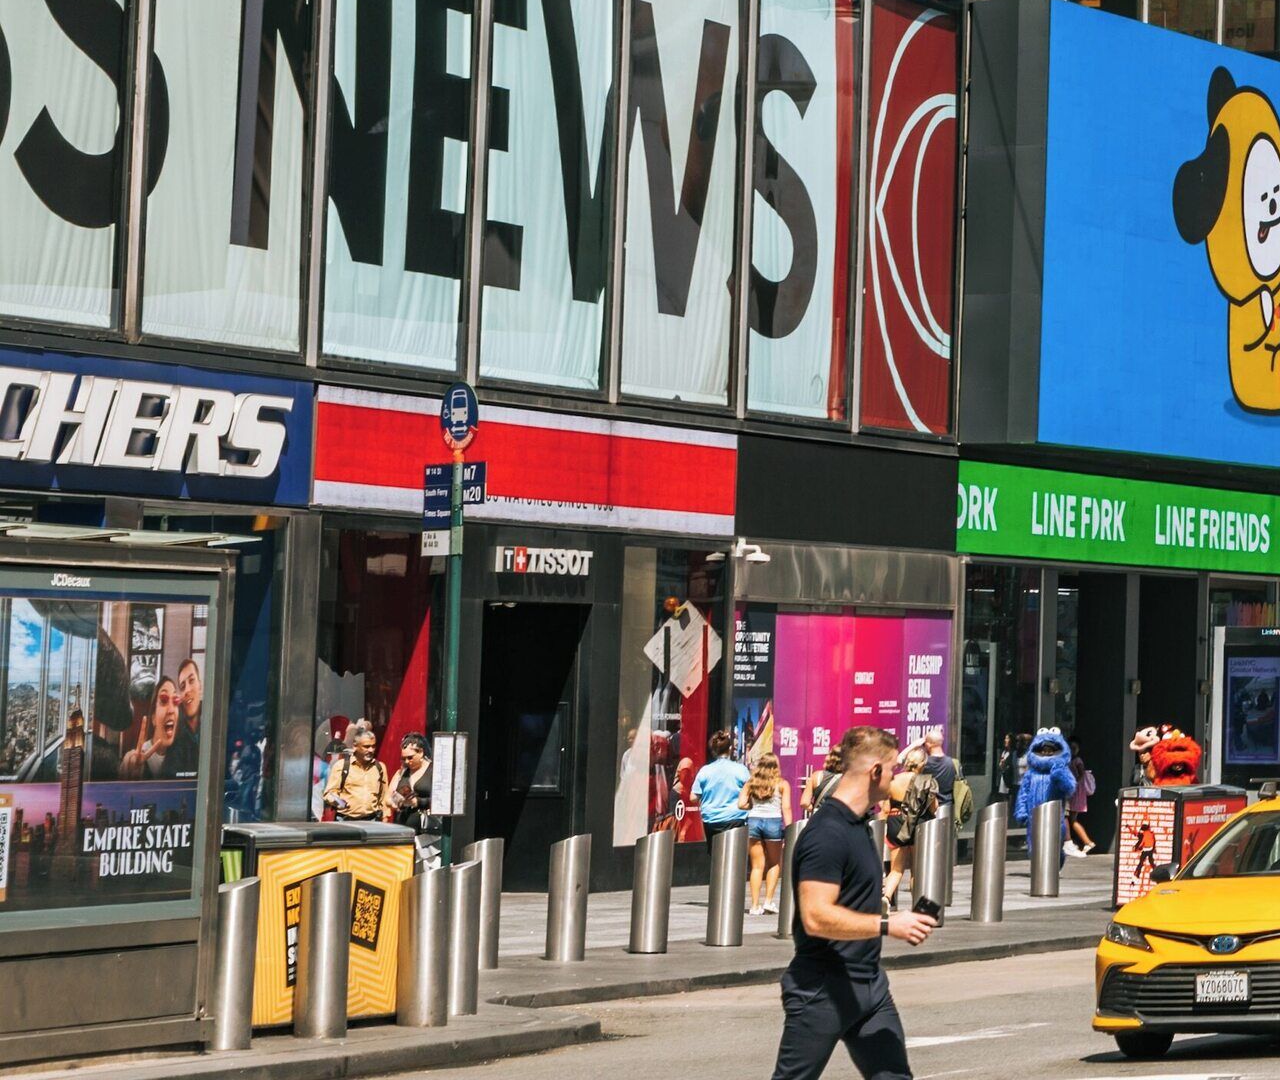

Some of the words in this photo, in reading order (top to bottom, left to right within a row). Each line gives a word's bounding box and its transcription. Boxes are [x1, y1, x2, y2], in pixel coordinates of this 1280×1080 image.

[463, 465, 477, 481] M7
[463, 486, 481, 502] M20
[1031, 491, 1076, 538] LINE
[1155, 503, 1195, 548] LINE
[1200, 508, 1270, 554] FRIENDS
[528, 547, 593, 576] TISSOT
[51, 573, 91, 588] JCDecaux
[909, 654, 943, 675] FLAGSHIP
[908, 678, 932, 699] RETAIL
[907, 702, 930, 723] SPACE
[130, 808, 150, 825] THE
[83, 826, 142, 853] EMPIRE
[144, 823, 191, 849] STATE
[99, 850, 173, 877] BUILDING
